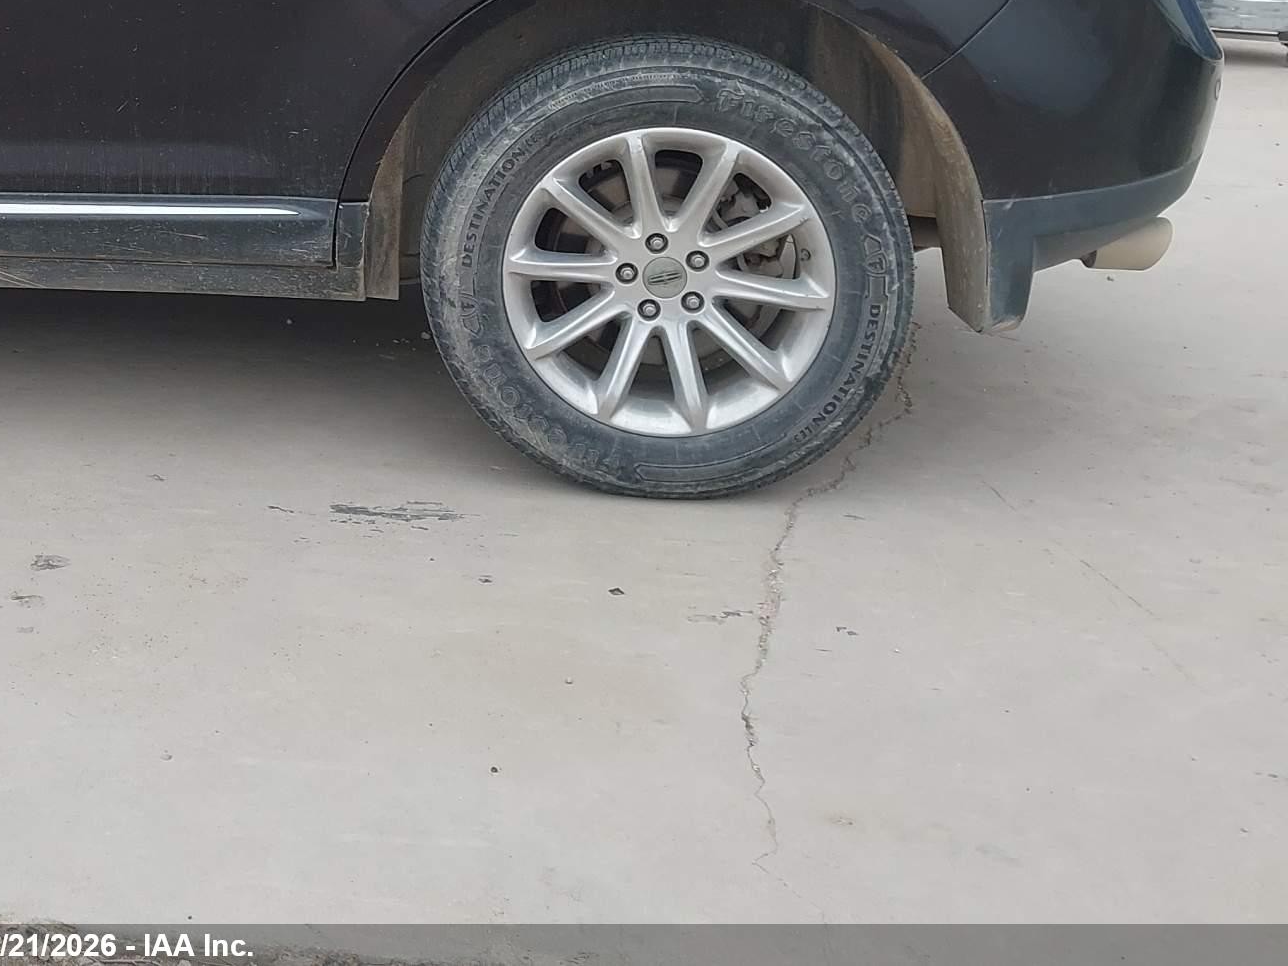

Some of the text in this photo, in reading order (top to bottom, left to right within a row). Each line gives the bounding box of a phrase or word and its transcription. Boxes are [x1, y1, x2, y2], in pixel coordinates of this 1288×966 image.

[461, 147, 526, 268] DESTINATION
[715, 86, 873, 224] Firestone
[812, 304, 881, 426] DESTINATION
